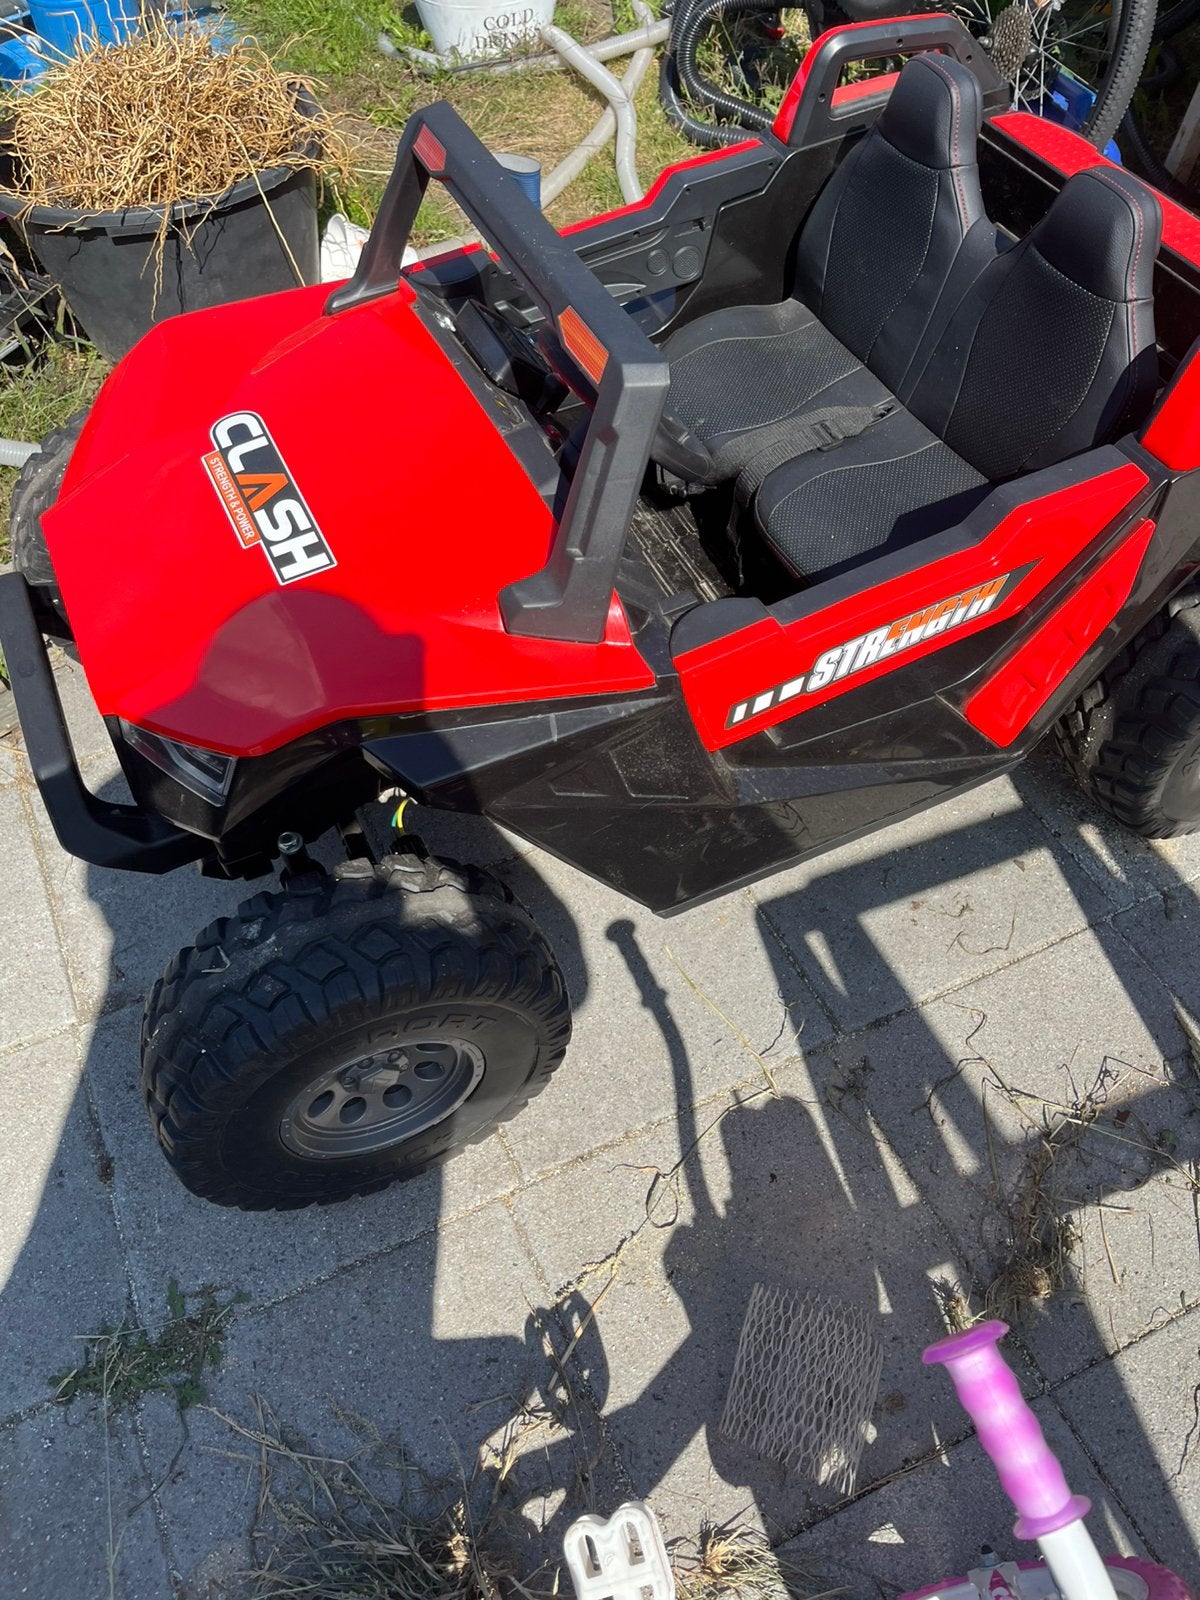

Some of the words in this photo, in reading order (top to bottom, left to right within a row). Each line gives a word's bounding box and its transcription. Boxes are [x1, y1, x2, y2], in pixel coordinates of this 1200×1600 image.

[483, 8, 534, 31] COLD
[210, 457, 236, 504] STRENGTH
[215, 413, 331, 580] CLASH
[230, 501, 240, 509] &
[234, 507, 255, 540] POWER
[806, 574, 1008, 693] STRENGTH
